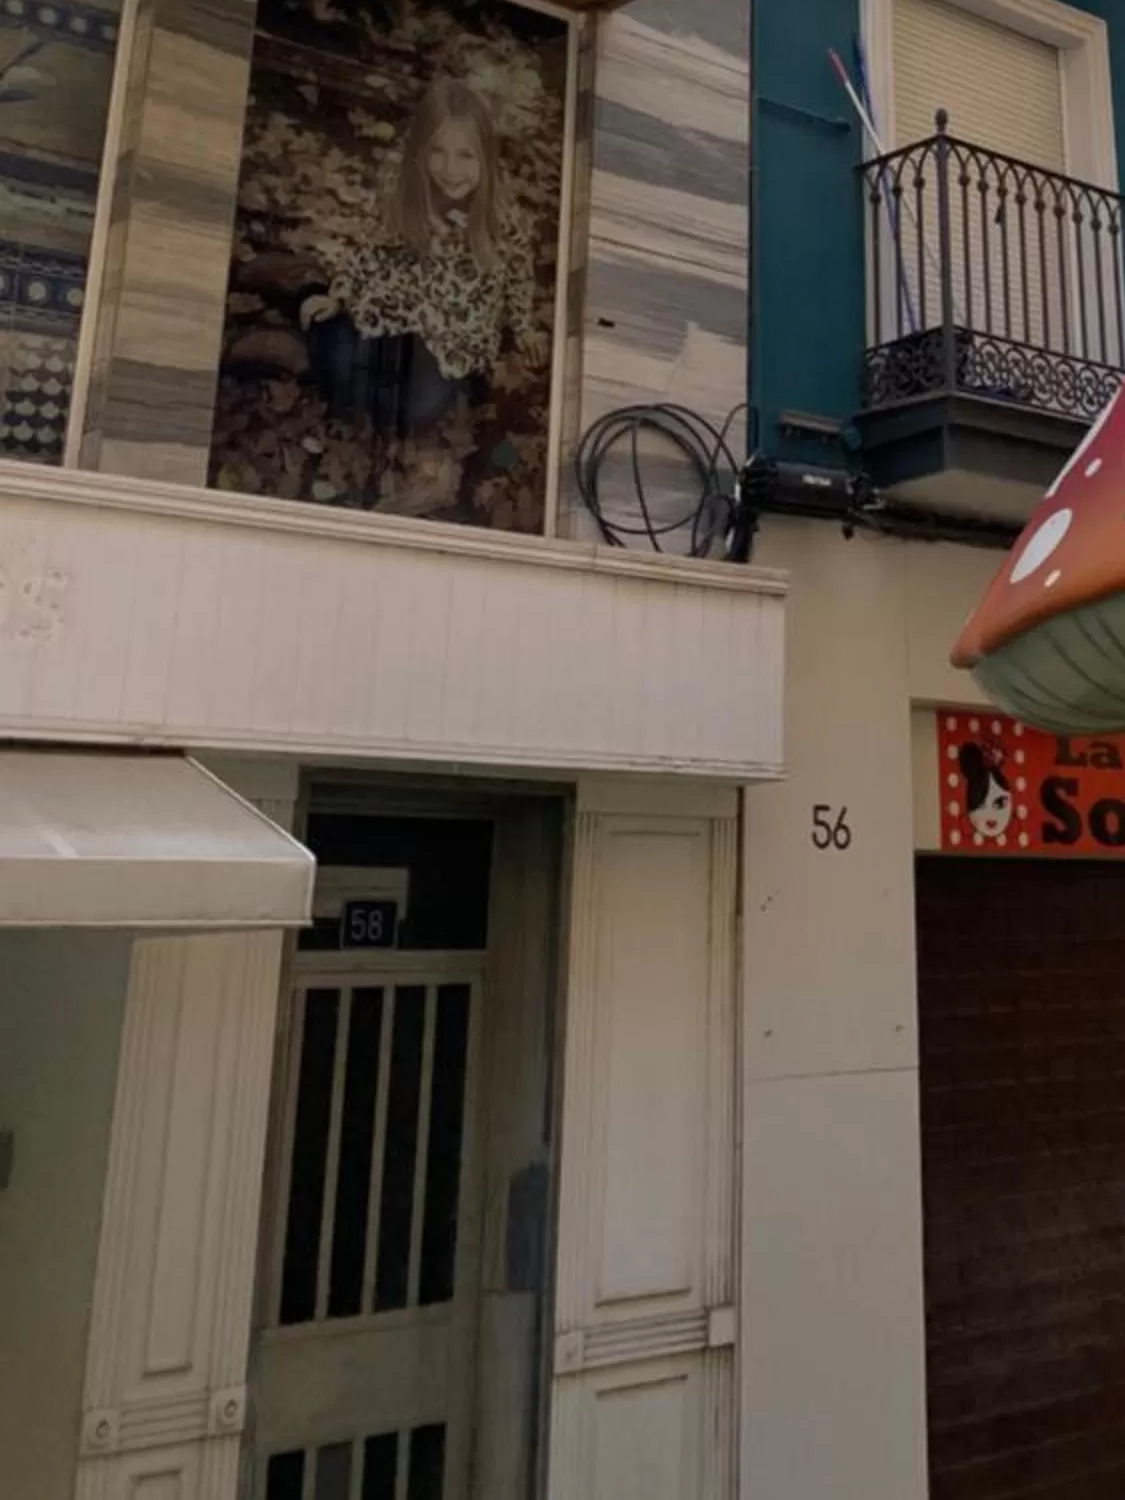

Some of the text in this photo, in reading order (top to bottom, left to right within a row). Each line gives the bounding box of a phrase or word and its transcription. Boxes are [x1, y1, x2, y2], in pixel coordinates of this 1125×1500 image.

[1055, 734, 1124, 770] La
[811, 804, 852, 850] 56
[351, 908, 383, 941] 58
